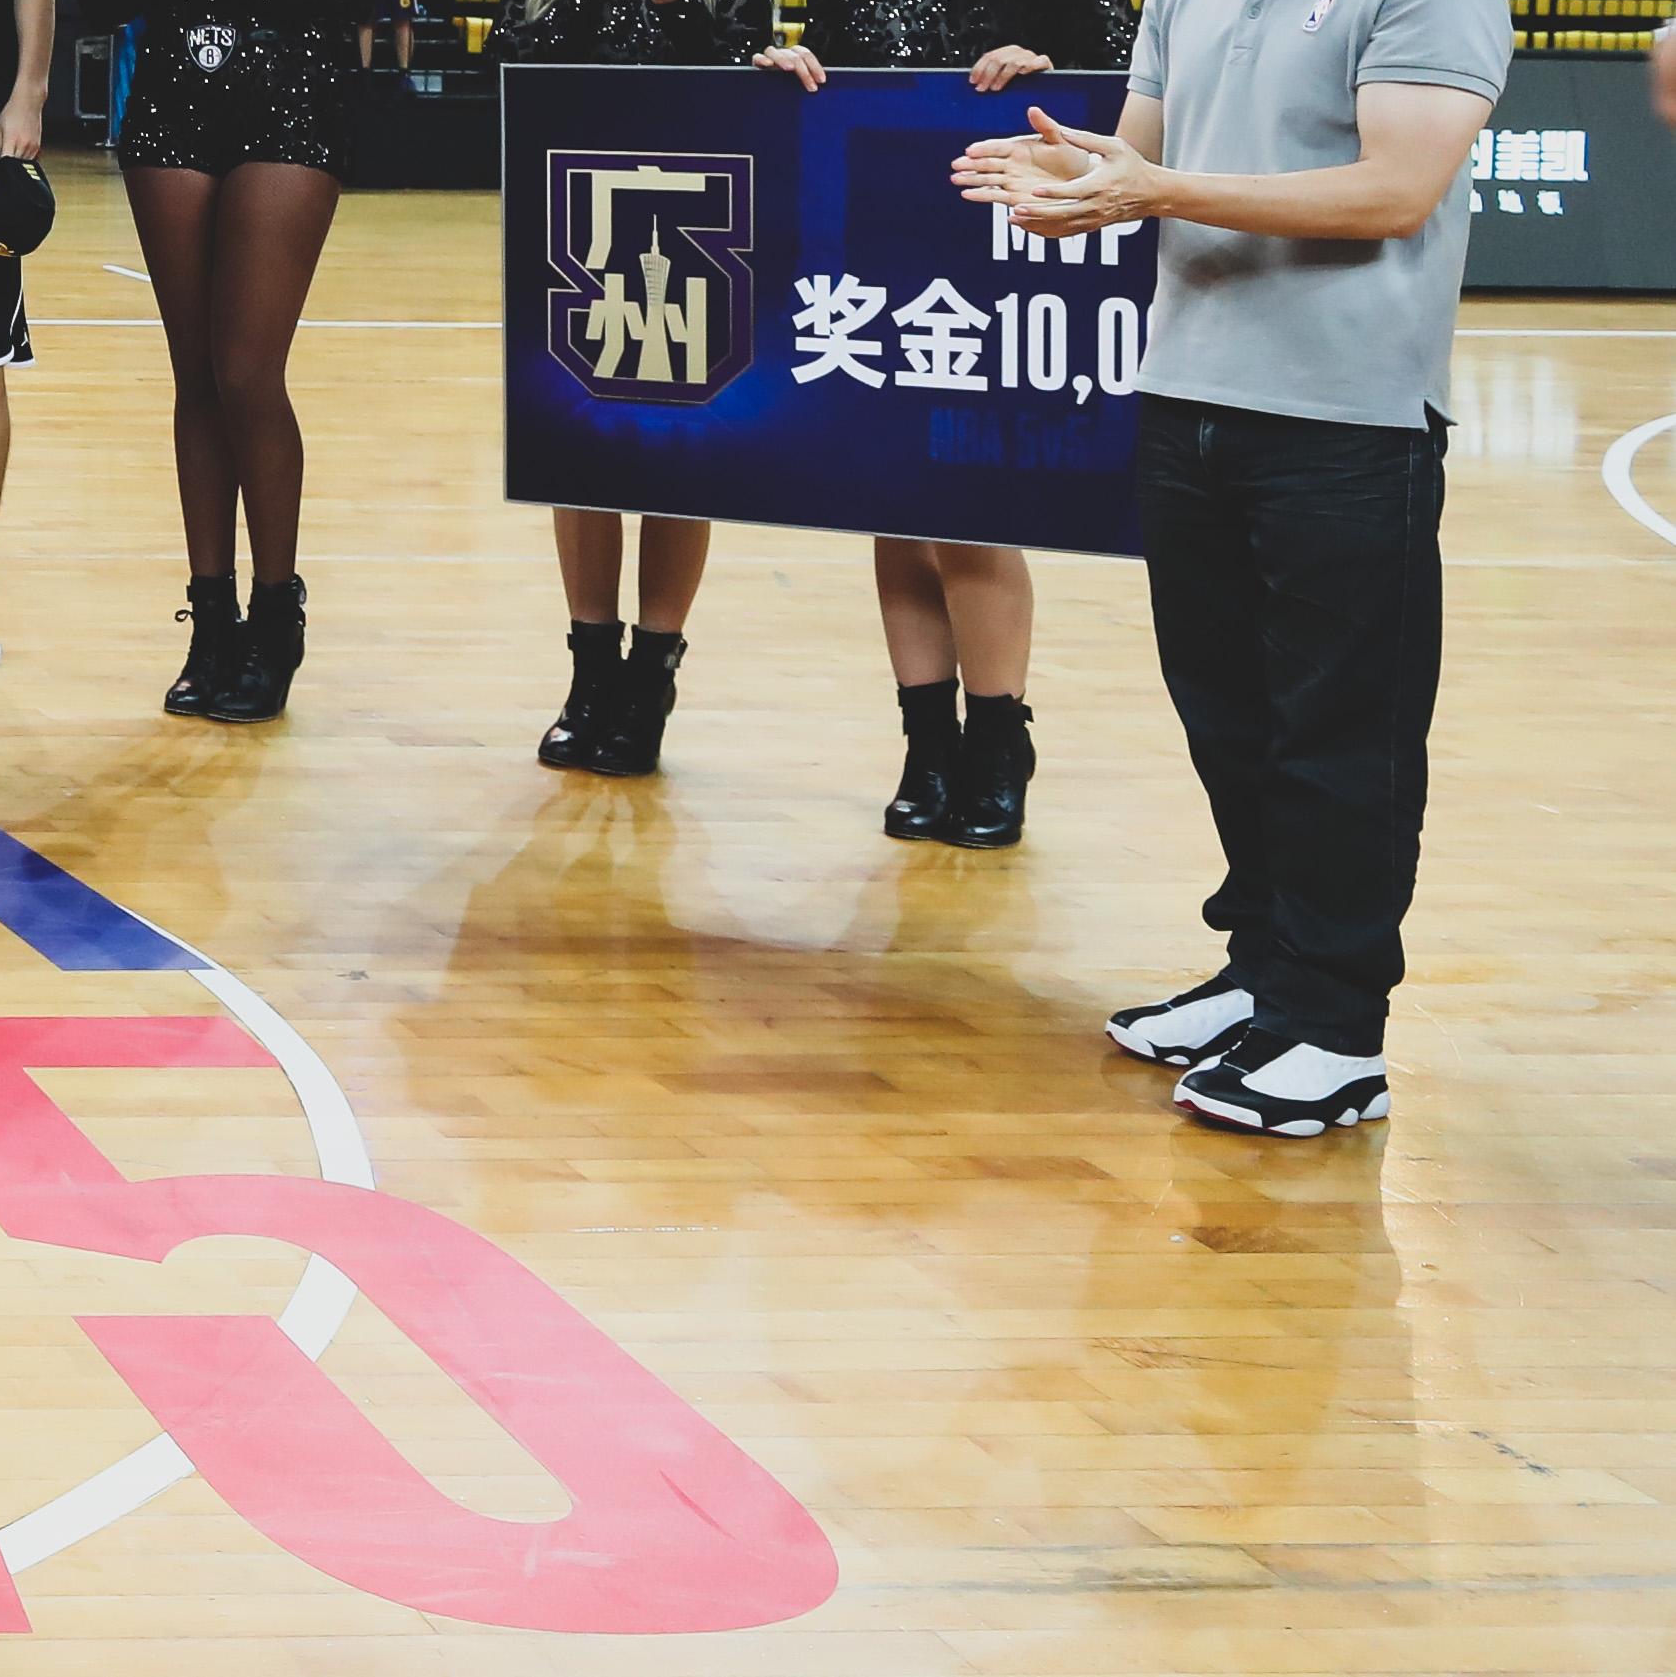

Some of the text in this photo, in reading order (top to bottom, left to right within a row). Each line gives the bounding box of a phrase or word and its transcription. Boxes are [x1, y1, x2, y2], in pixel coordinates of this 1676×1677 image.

[189, 26, 233, 48] NETS
[584, 165, 707, 384] 广州
[790, 273, 1153, 405] 奖金10,0
